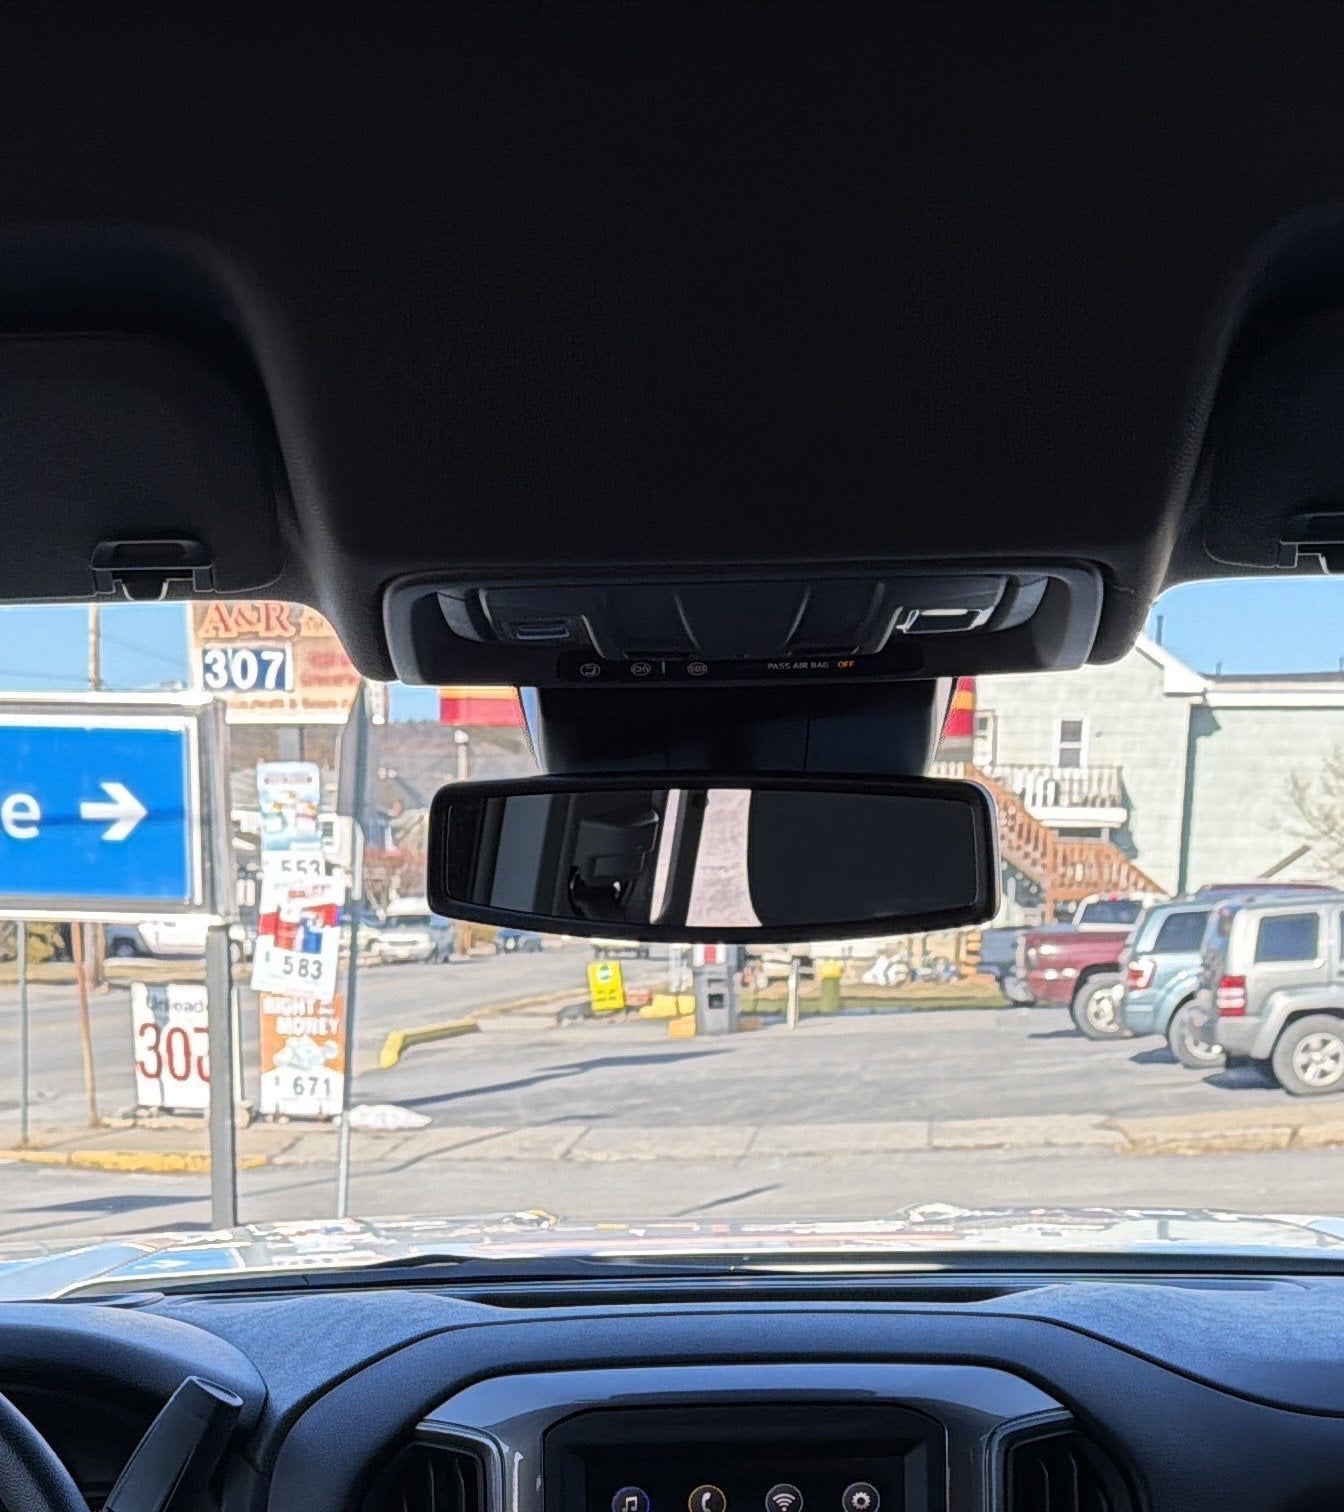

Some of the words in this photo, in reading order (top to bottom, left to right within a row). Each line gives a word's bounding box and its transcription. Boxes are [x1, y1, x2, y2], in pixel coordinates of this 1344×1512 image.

[205, 649, 285, 691] 307
[767, 662, 791, 670] PASS
[792, 661, 808, 669] AIR
[810, 661, 829, 669] BAG
[836, 660, 855, 669] OFF
[281, 955, 323, 980] 583
[292, 1076, 332, 1096] 671
